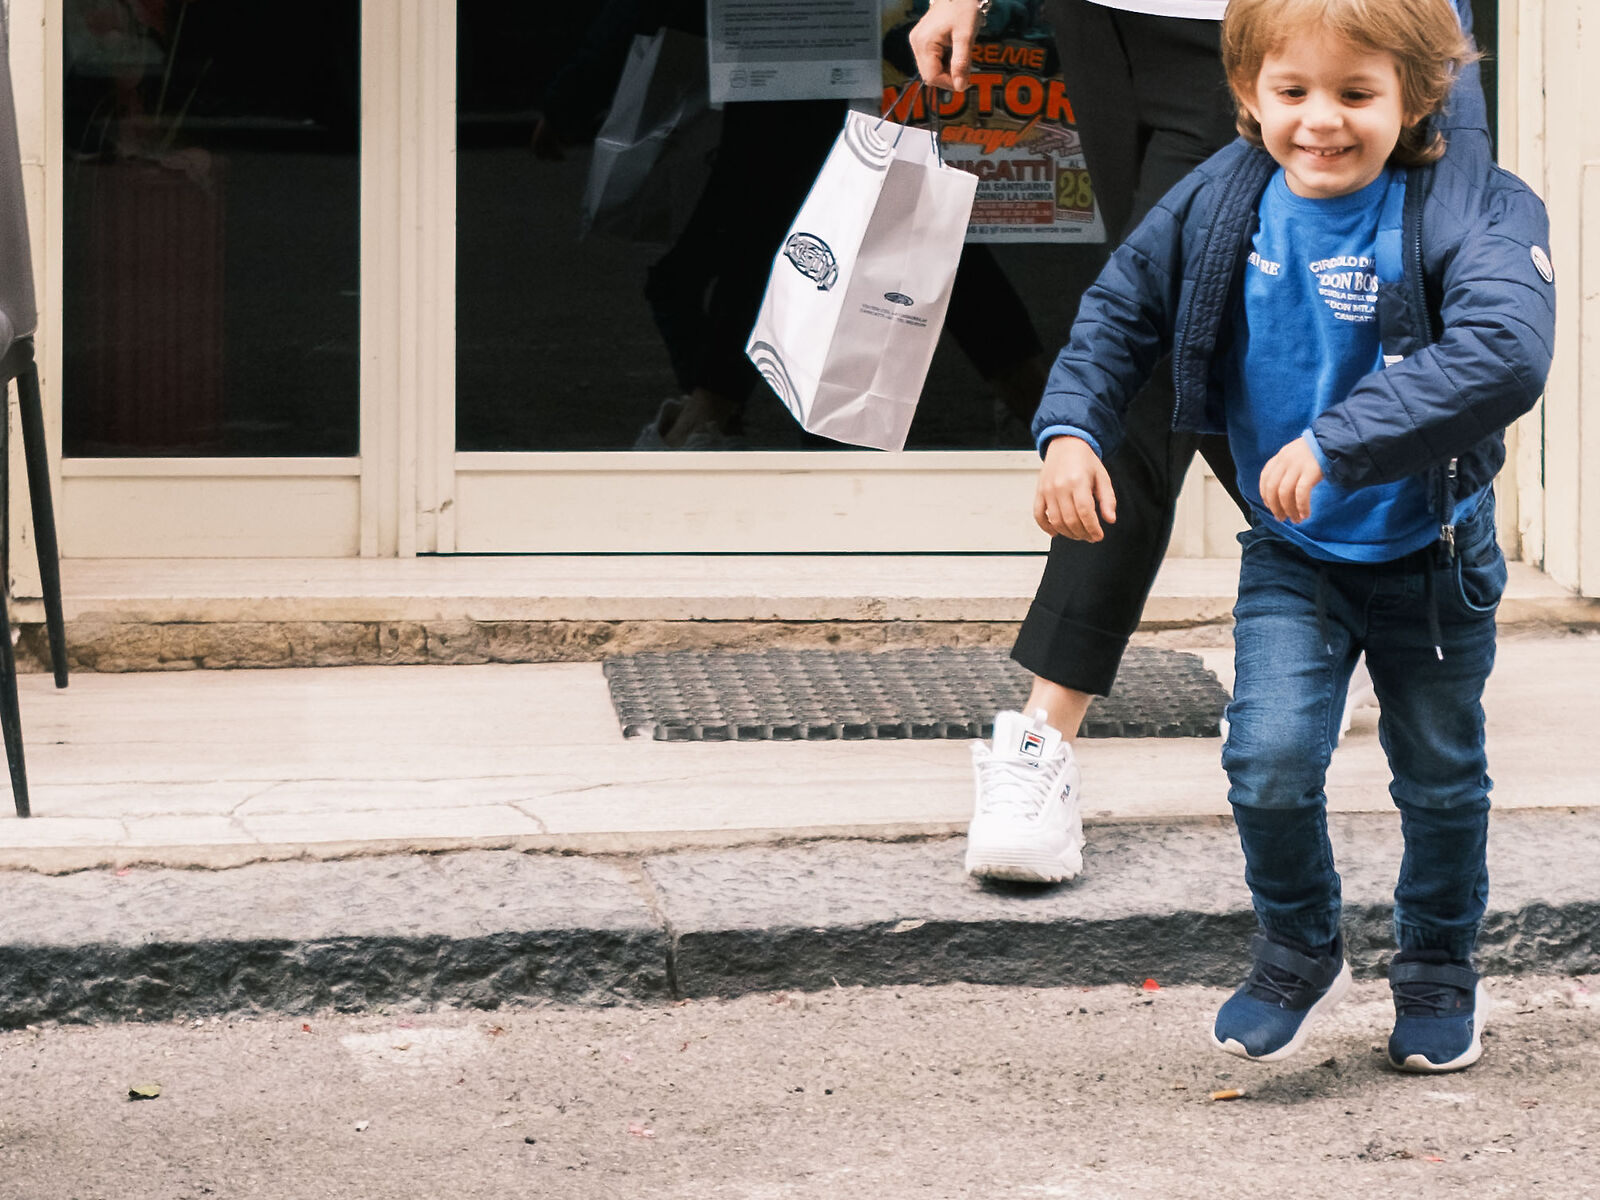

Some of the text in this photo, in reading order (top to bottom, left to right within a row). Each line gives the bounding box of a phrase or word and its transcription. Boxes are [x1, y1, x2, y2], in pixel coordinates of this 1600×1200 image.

[971, 43, 1046, 68] REME
[993, 182, 1051, 192] SANTUARIO
[1007, 192, 1020, 201] LA
[1059, 171, 1093, 208] 28
[1354, 272, 1379, 293] BOS
